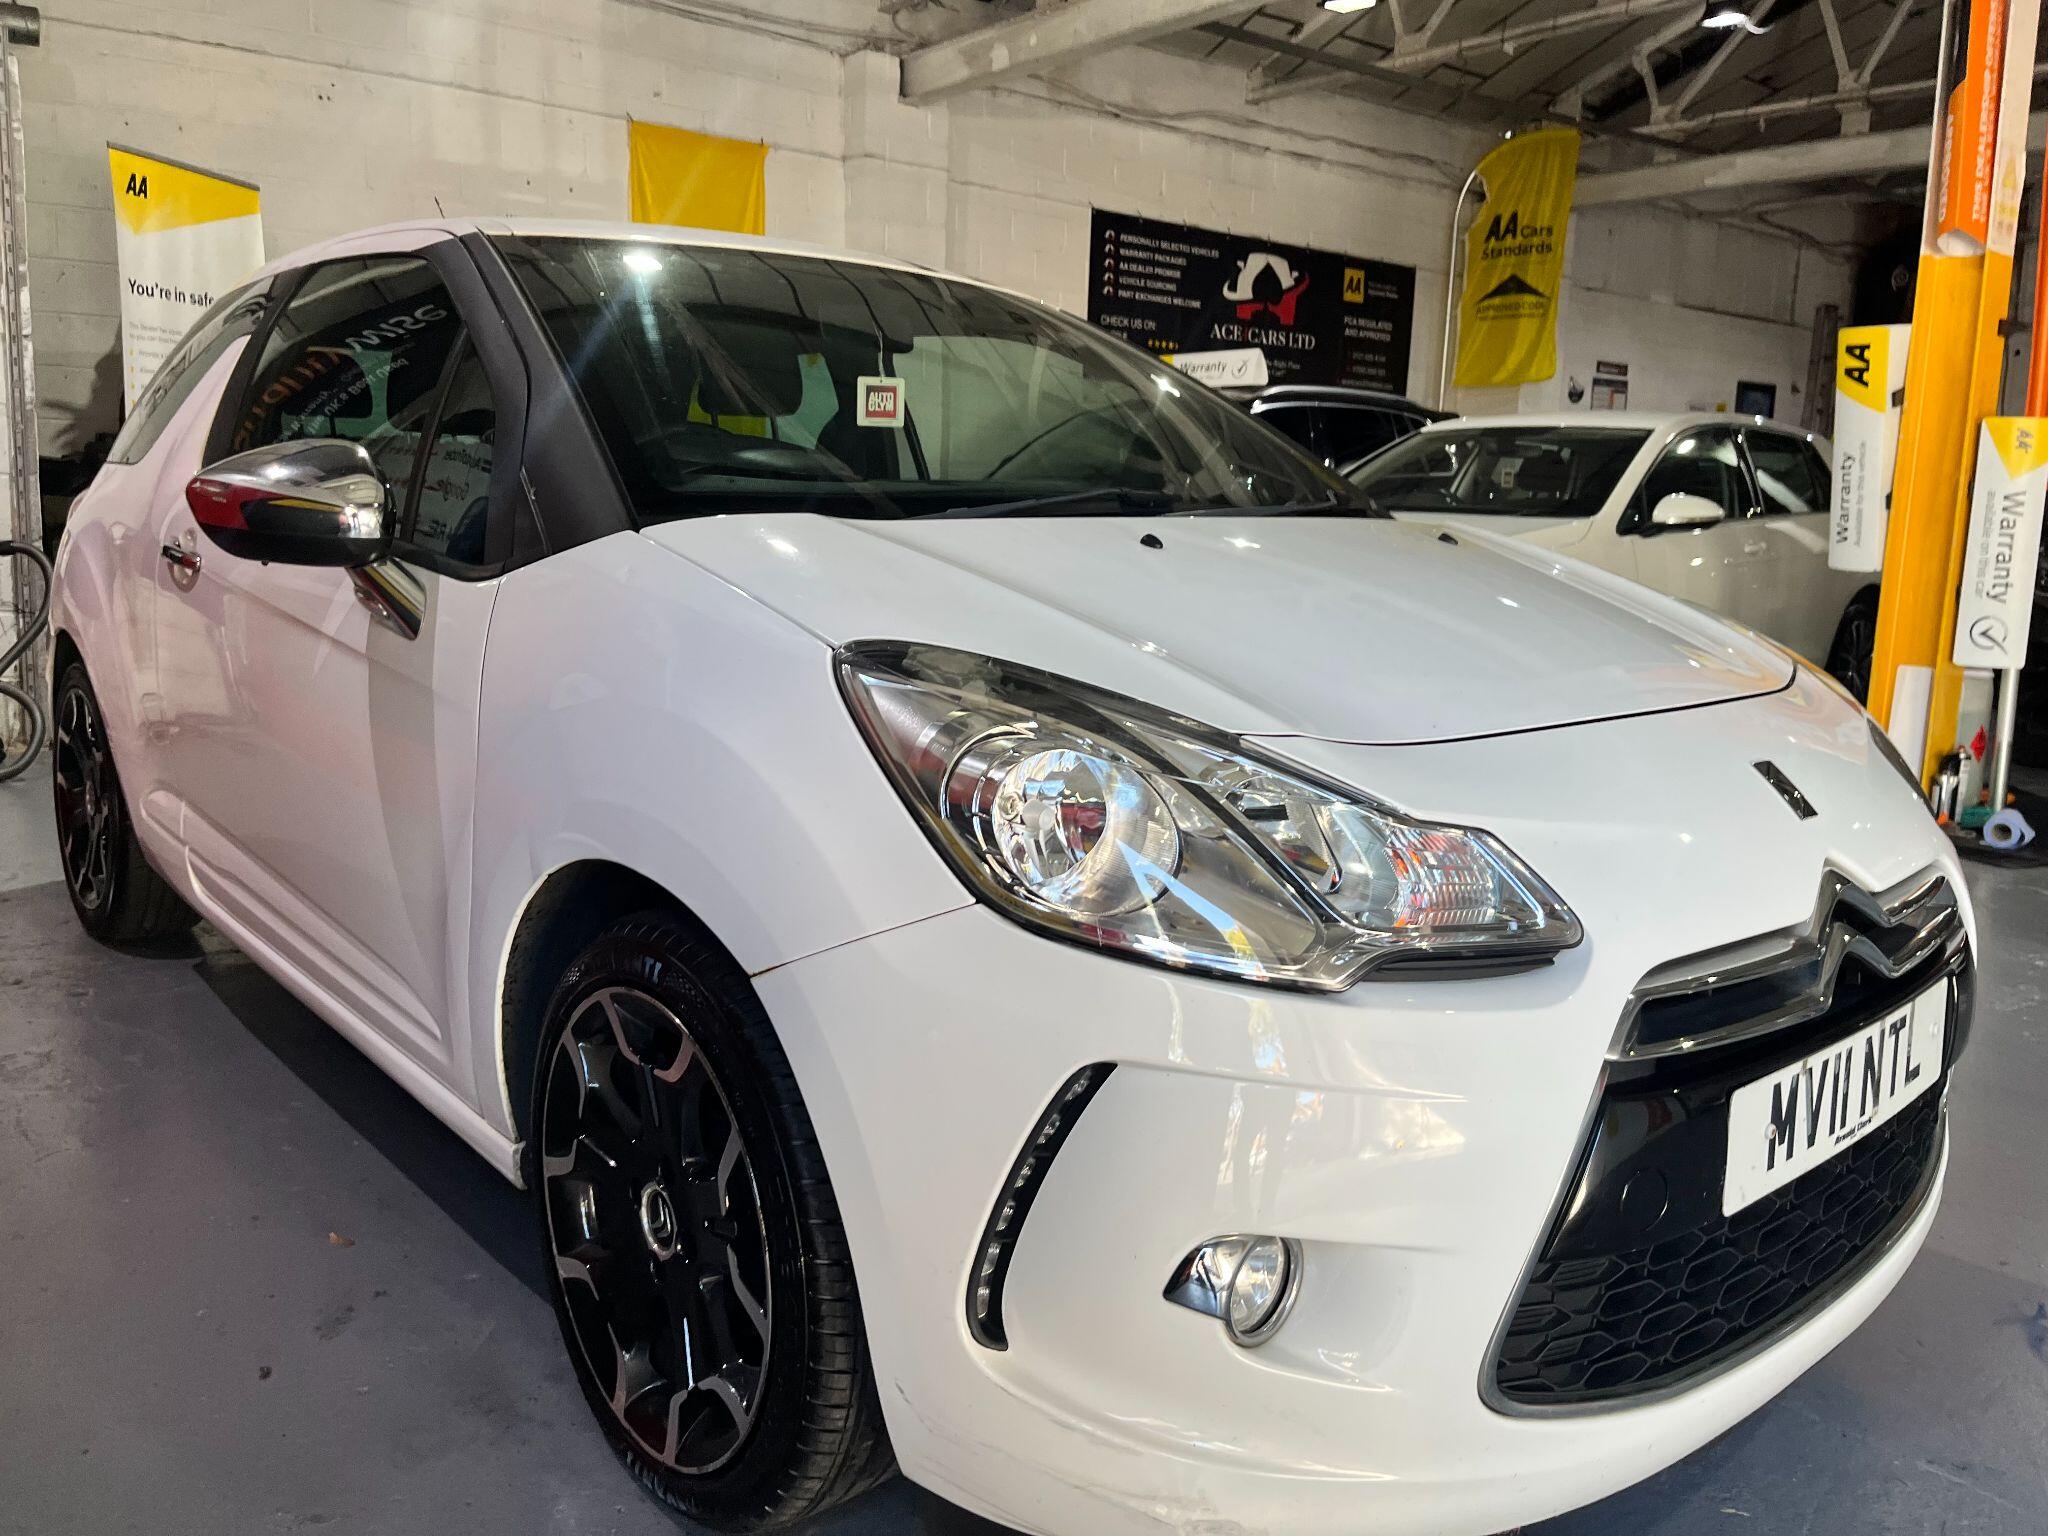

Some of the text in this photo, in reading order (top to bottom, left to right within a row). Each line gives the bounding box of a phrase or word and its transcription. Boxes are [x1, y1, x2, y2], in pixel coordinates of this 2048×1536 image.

[125, 173, 148, 199] AA
[1484, 208, 1553, 243] AA Cars
[1481, 241, 1552, 260] Standards
[128, 277, 171, 300] You're
[174, 286, 186, 303] in
[1345, 275, 1362, 295] AA
[1100, 314, 1156, 331] CHECK US ON
[1210, 323, 1316, 350] ACE CARS LTD
[1180, 360, 1228, 376] Warranty
[1844, 344, 1870, 387] AA
[1836, 452, 1856, 545] Warranty
[1974, 488, 1997, 599] available on this car
[1986, 490, 2027, 605] Warranty
[1859, 1008, 1921, 1118] NTL
